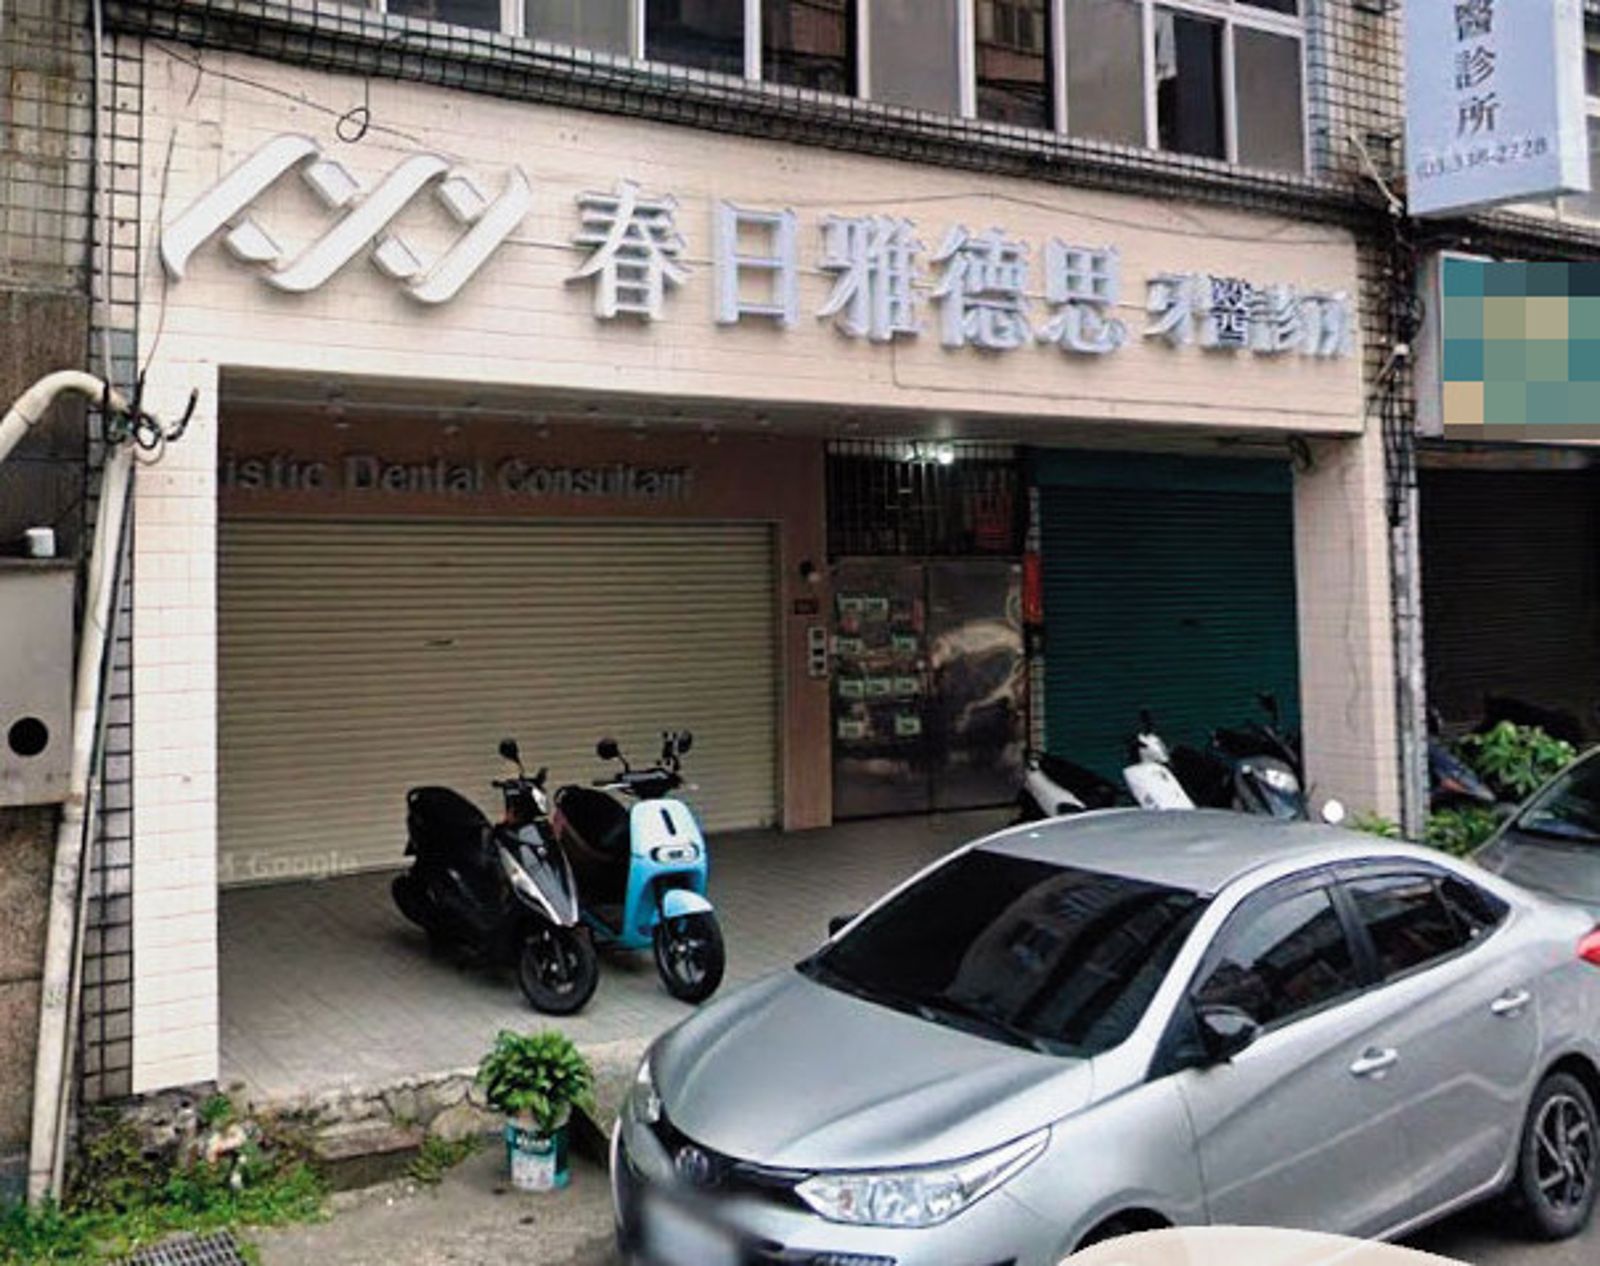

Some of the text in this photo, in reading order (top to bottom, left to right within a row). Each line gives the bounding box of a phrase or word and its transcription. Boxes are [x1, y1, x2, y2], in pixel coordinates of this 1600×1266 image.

[565, 178, 1355, 357] 春日雅德思 牙醫診所
[344, 454, 483, 495] Dental
[496, 456, 697, 501] Consultant
